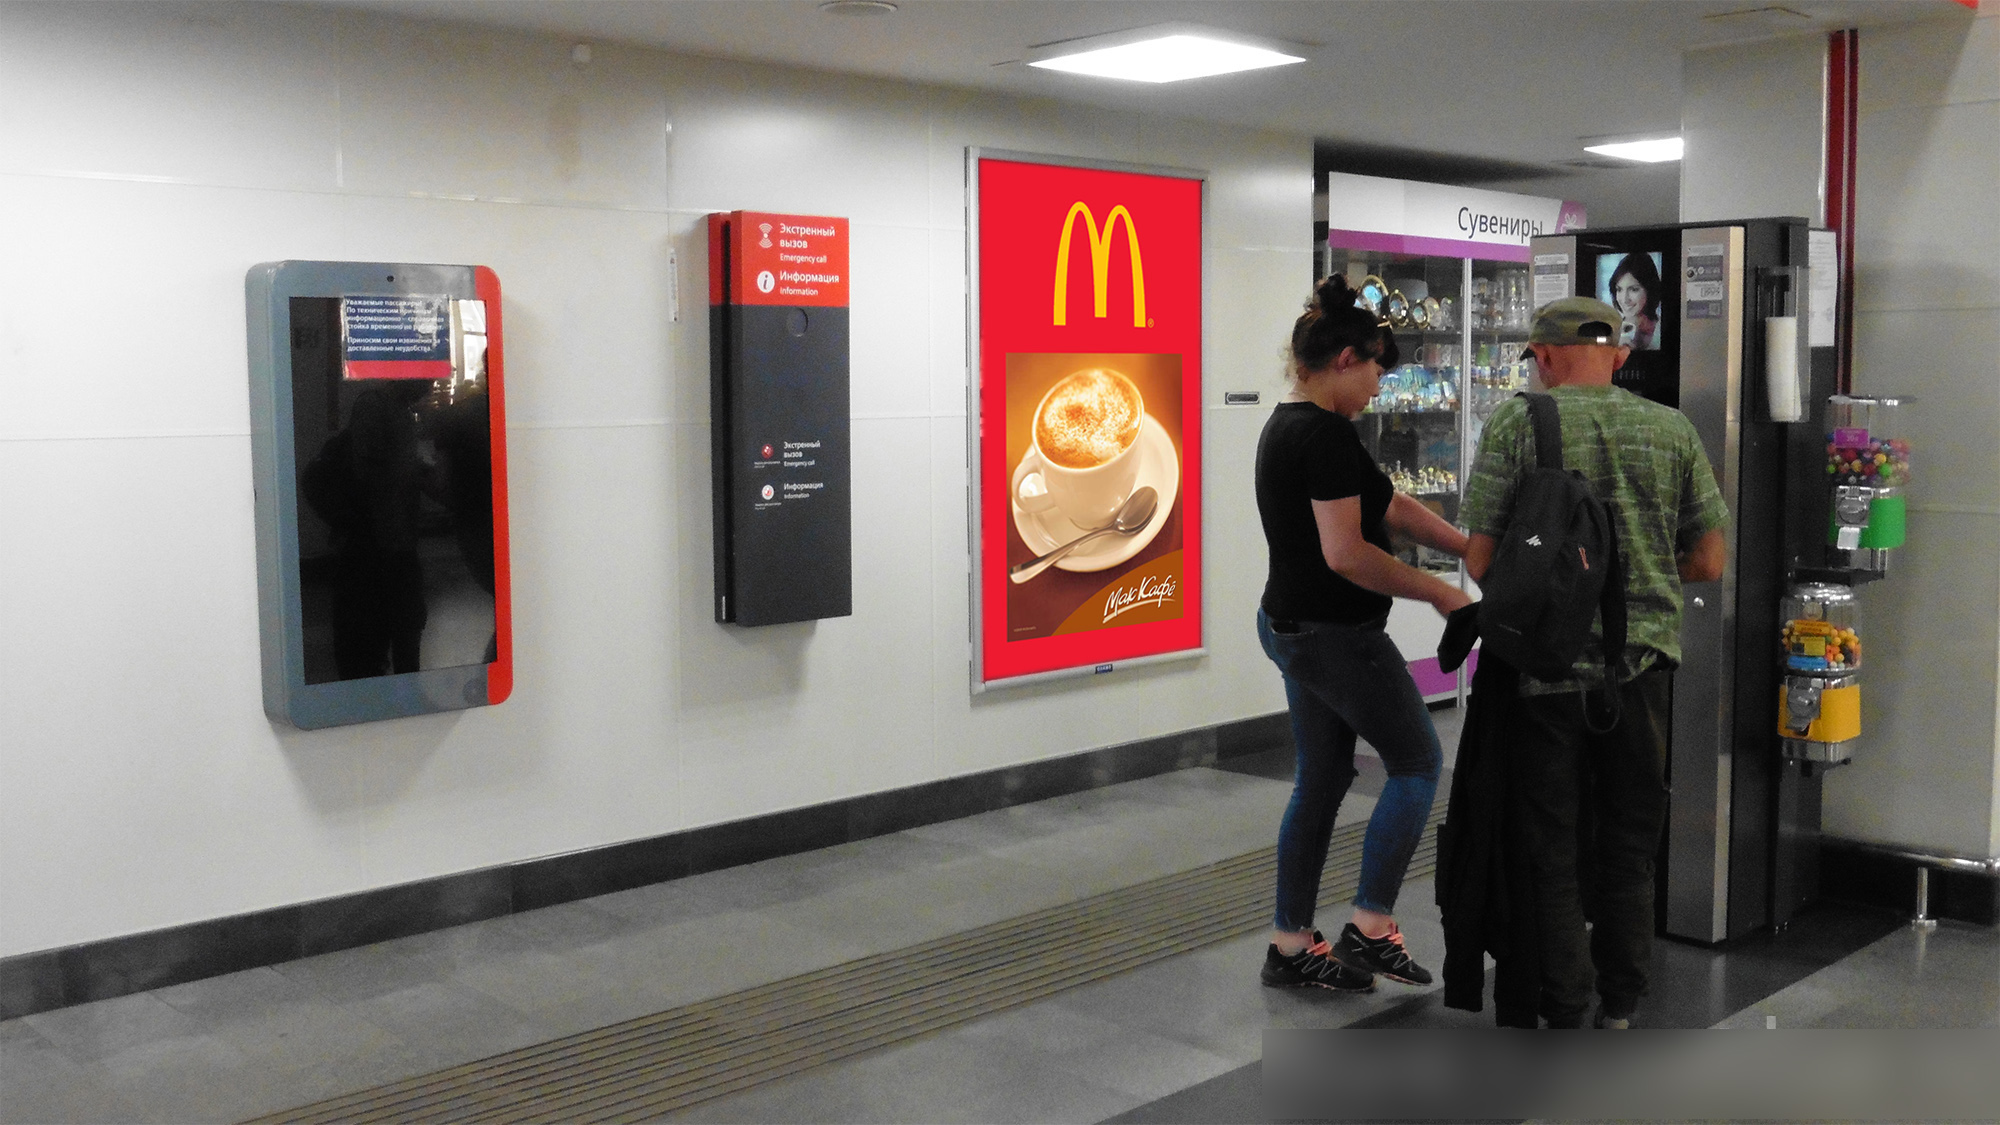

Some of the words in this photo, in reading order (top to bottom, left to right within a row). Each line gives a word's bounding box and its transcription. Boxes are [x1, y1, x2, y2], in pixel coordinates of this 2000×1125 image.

[1458, 206, 1543, 243] Сувениры
[780, 223, 835, 237] Экстренный
[780, 239, 808, 249] вызов
[780, 253, 815, 264] Emergency
[816, 255, 827, 263] call
[780, 270, 839, 283] Информация
[780, 287, 818, 296] Information
[347, 322, 369, 330] стойка
[784, 440, 820, 449] Экстренный
[784, 482, 823, 491] Информация
